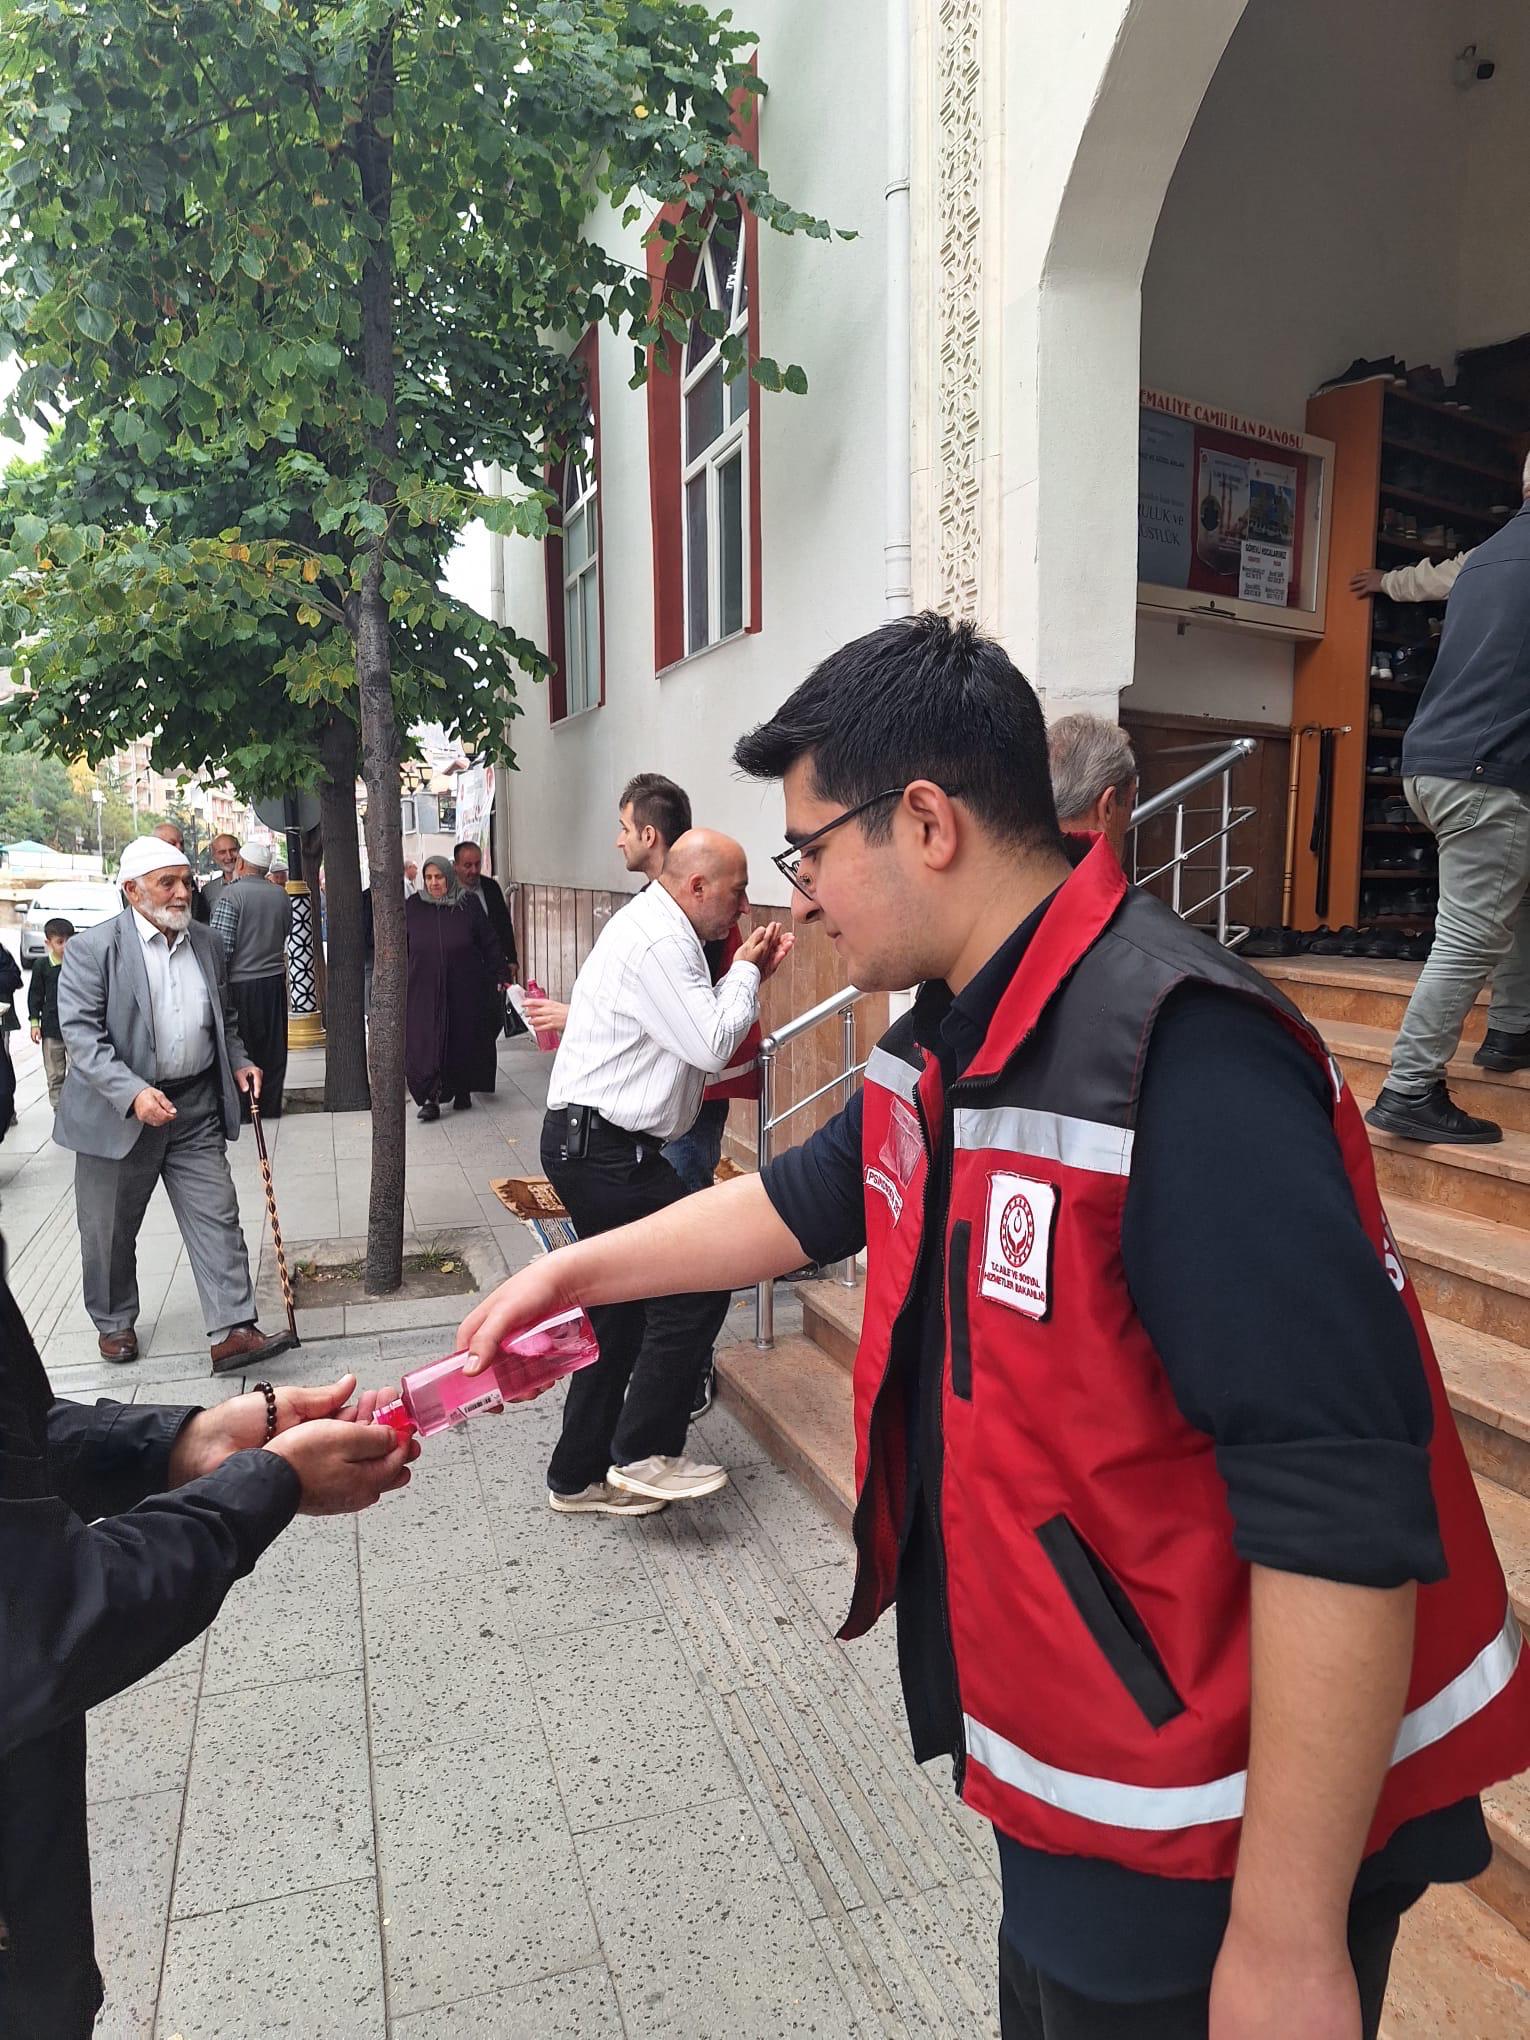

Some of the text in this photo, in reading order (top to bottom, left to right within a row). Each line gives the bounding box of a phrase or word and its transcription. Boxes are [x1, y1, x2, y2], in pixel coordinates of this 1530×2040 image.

[1230, 415, 1255, 435] İLAN
[1259, 424, 1303, 448] PANOSU
[1019, 1272, 1041, 1289] SOSYAL
